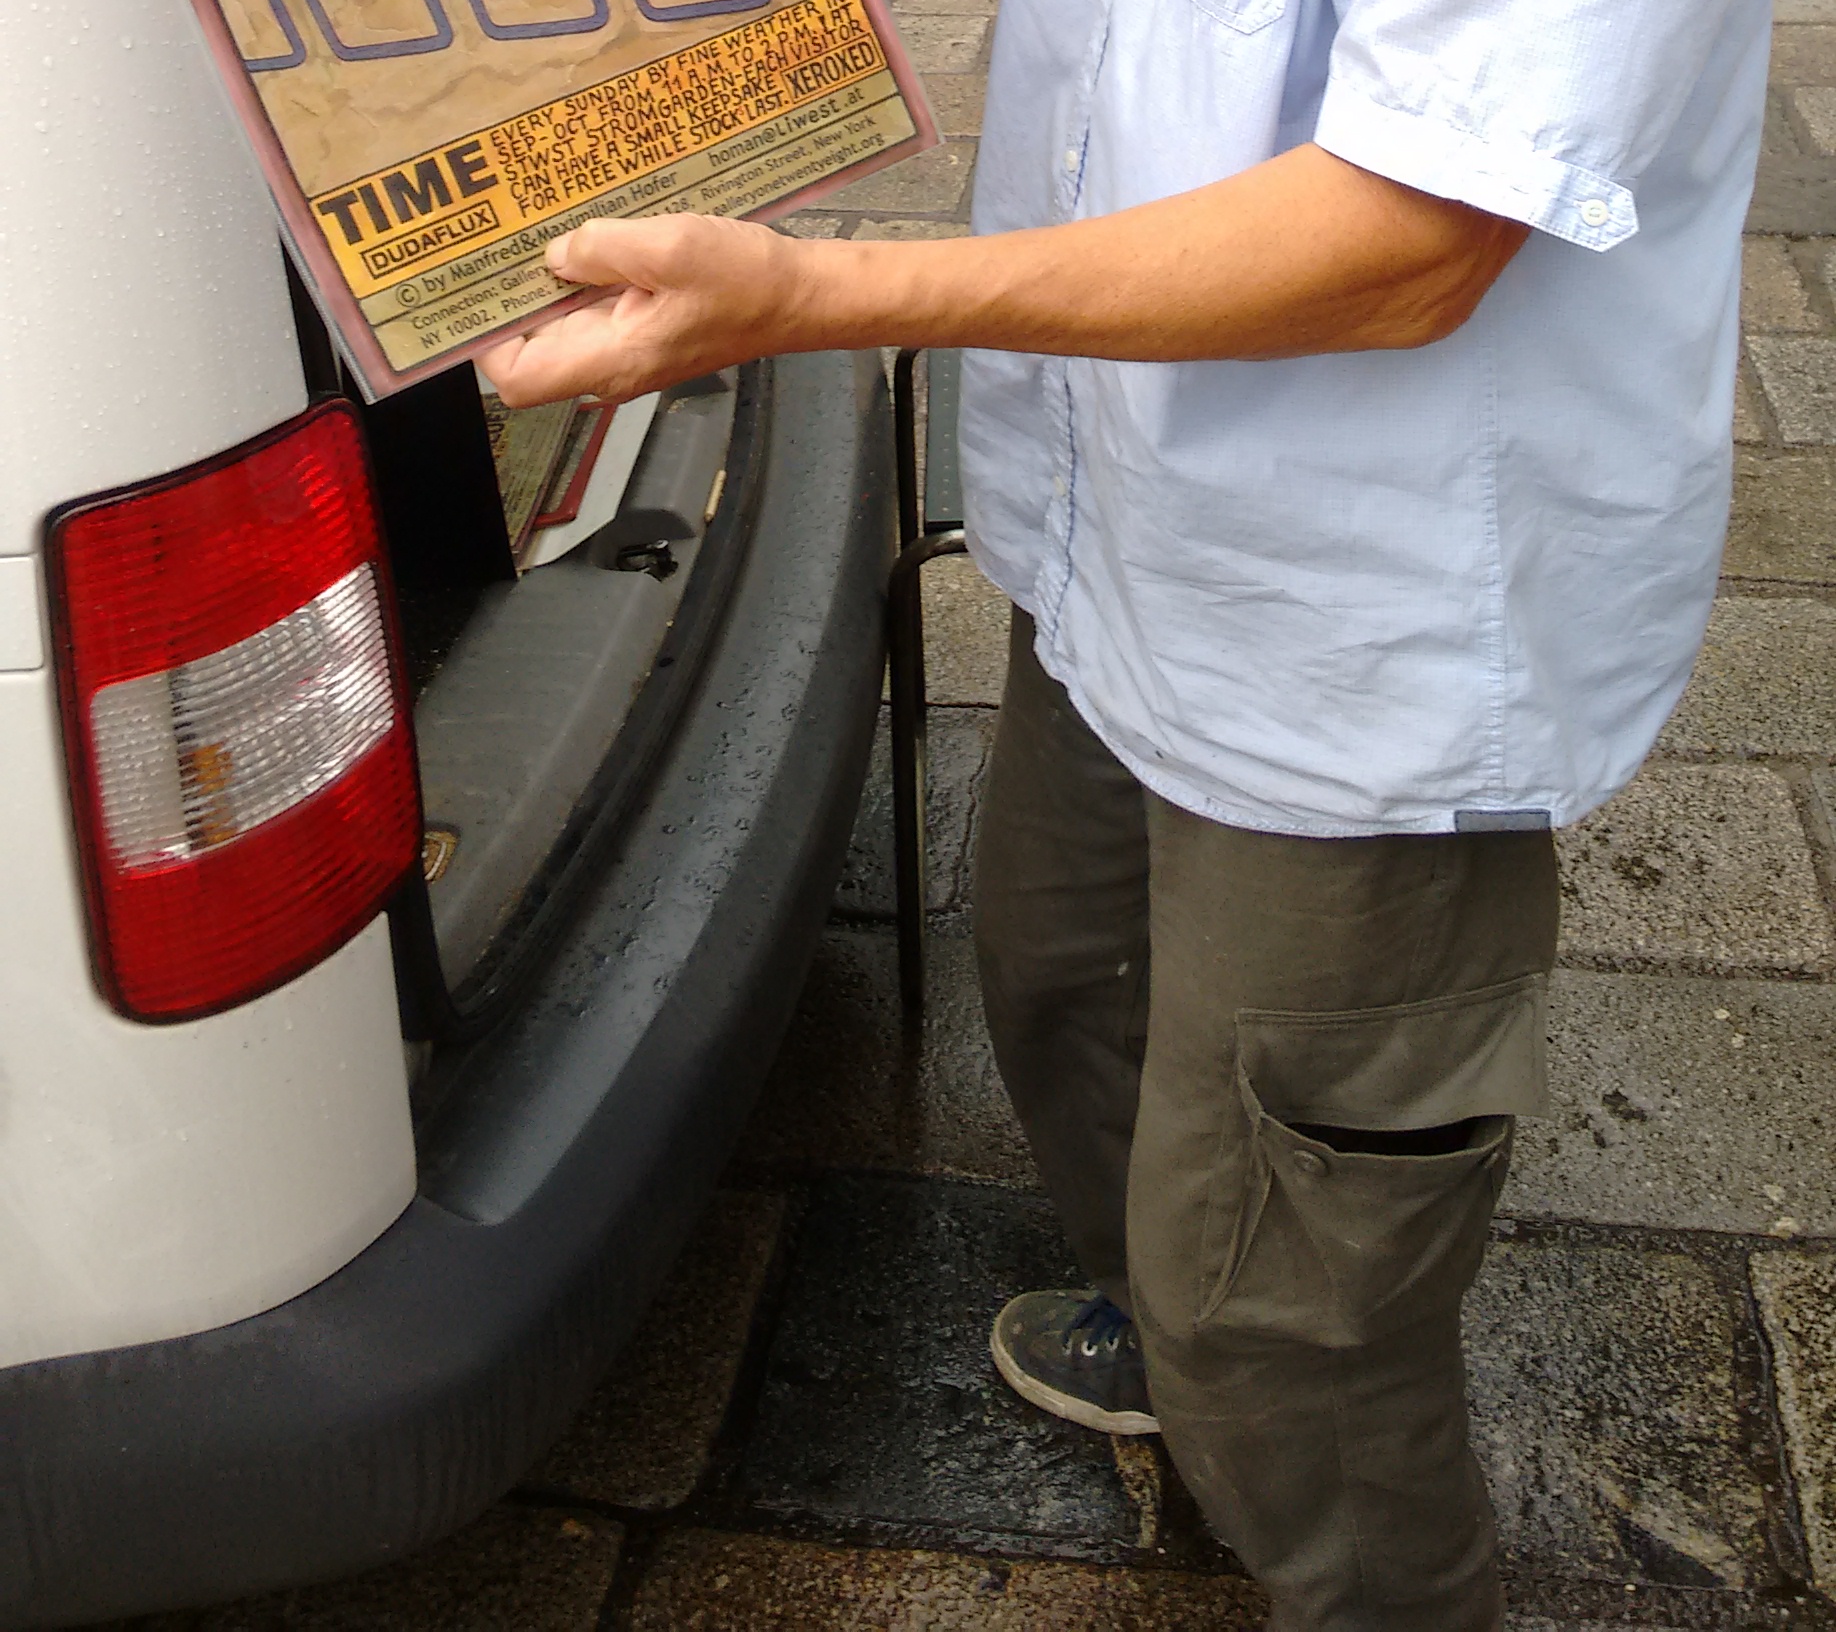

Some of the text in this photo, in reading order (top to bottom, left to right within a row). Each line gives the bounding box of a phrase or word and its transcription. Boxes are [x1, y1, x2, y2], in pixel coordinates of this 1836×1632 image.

[490, 108, 554, 147] EVERY
[565, 73, 639, 116] SUNDAY
[647, 61, 669, 84] BY
[677, 41, 721, 70] FINE
[722, 1, 820, 50] WEATHER
[504, 137, 576, 181] STWST
[789, 19, 865, 60] VISITOR
[553, 114, 588, 139] OCT
[598, 88, 655, 121] FROM
[662, 75, 682, 95] 11
[728, 46, 753, 66] TO
[759, 39, 774, 57] 2
[831, 2, 854, 27] AT
[785, 41, 876, 99] XEROXED
[318, 139, 499, 246] TIME
[510, 73, 777, 200] CAN HAVE A SMALL KEEPSAKE
[518, 187, 559, 218] FOR
[563, 161, 617, 199] FREE
[618, 132, 687, 174] WHILE
[371, 208, 494, 269] DUDAFLUX
[412, 285, 499, 331] Connection:
[701, 165, 764, 201] Rivington
[813, 131, 843, 150] New
[844, 114, 876, 137] York
[420, 327, 443, 349] NY
[704, 132, 885, 217] galleryonetwentyeight.org
[425, 272, 446, 293] by
[631, 171, 677, 201] Hofer
